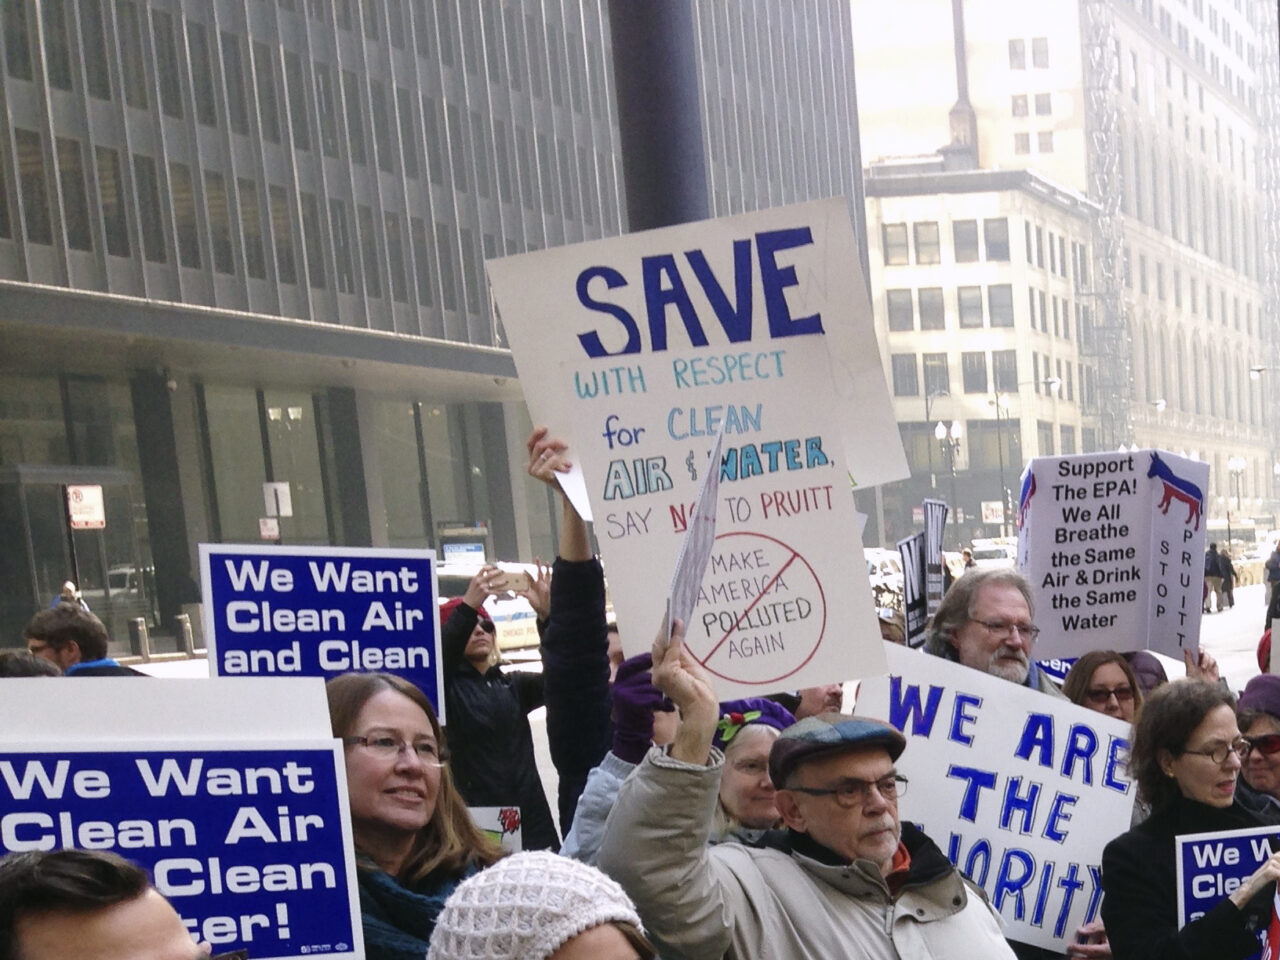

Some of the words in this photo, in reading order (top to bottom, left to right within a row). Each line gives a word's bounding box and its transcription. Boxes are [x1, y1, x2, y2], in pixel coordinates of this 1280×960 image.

[576, 226, 825, 359] SAVE
[574, 367, 647, 399] WITH
[673, 350, 786, 390] RESPECT
[603, 416, 646, 449] for
[667, 403, 763, 440] CLEAN
[603, 455, 673, 501] AIR
[1058, 456, 1134, 478] Support
[1053, 483, 1089, 501] The
[1093, 481, 1137, 498] EPA!
[606, 508, 653, 540] SAY
[669, 502, 696, 533] N
[725, 497, 752, 524] TO
[761, 486, 833, 520] PRUITT
[1062, 506, 1091, 523] We
[1096, 503, 1121, 521] All
[1055, 524, 1130, 544] Breathe
[711, 550, 770, 581] MAKE
[1051, 551, 1082, 568] the
[1084, 547, 1136, 565] Same
[224, 560, 294, 593] We
[308, 561, 419, 594] Want
[697, 574, 789, 606] AMERICA
[1042, 571, 1070, 589] Air
[1075, 569, 1089, 585] &
[1093, 566, 1141, 584] Drink
[1052, 593, 1083, 610] the
[1085, 588, 1137, 605] Same
[226, 601, 345, 633] Clean
[361, 601, 424, 631] Air
[703, 597, 812, 638] POLLUTED
[1062, 613, 1118, 631] Water
[224, 641, 301, 674] and
[318, 640, 430, 672] Clean
[728, 638, 786, 659] AGAIN
[888, 676, 983, 747] WE
[1015, 712, 1133, 795] ARE
[0, 759, 111, 801] We
[136, 758, 315, 798] Want
[947, 764, 1079, 845] THE
[2, 811, 197, 853] Clean
[224, 806, 325, 845] Air
[1192, 843, 1240, 869] We
[153, 857, 336, 898] Clean
[1192, 873, 1252, 899] Cle
[178, 902, 291, 943] ter!
